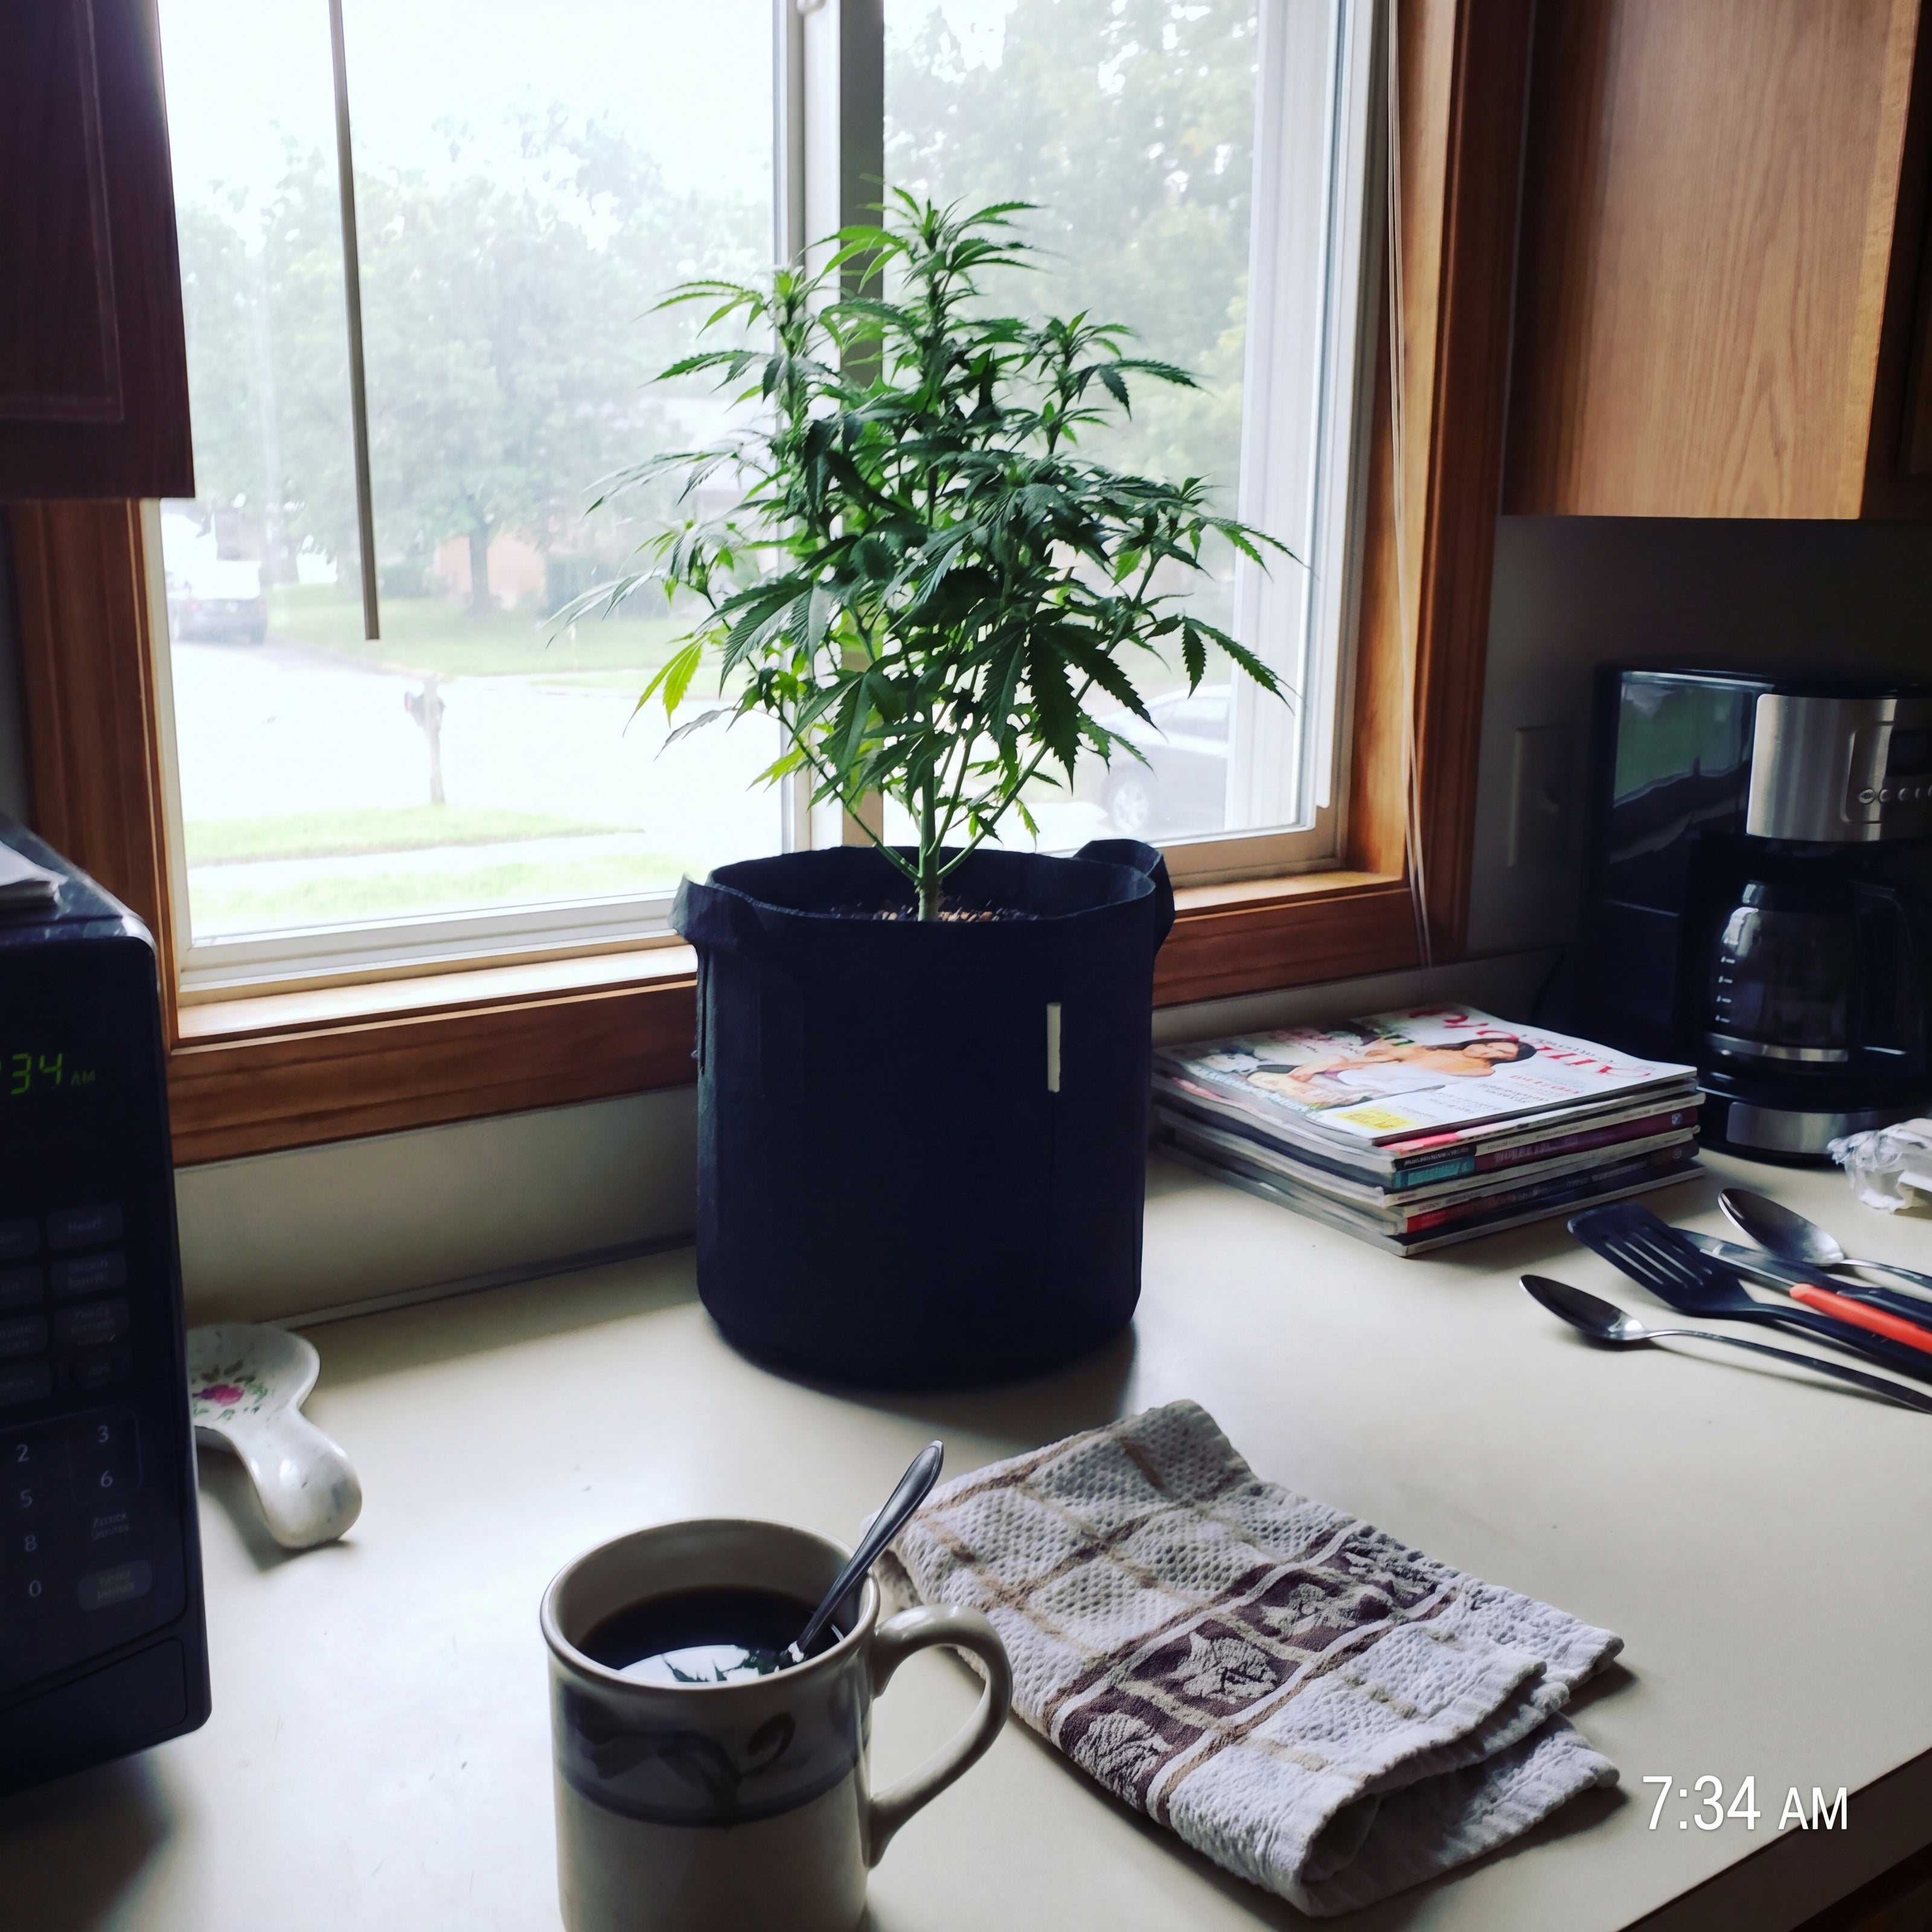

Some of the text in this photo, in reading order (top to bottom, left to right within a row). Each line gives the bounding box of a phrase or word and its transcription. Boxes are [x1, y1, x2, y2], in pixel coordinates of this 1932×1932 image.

[71, 1070, 96, 1086] AM
[97, 1424, 109, 1444] 3
[16, 1443, 30, 1463] 2
[100, 1470, 114, 1488] 6
[19, 1489, 33, 1508] 5
[24, 1534, 37, 1553] 8
[28, 1579, 42, 1599] 0
